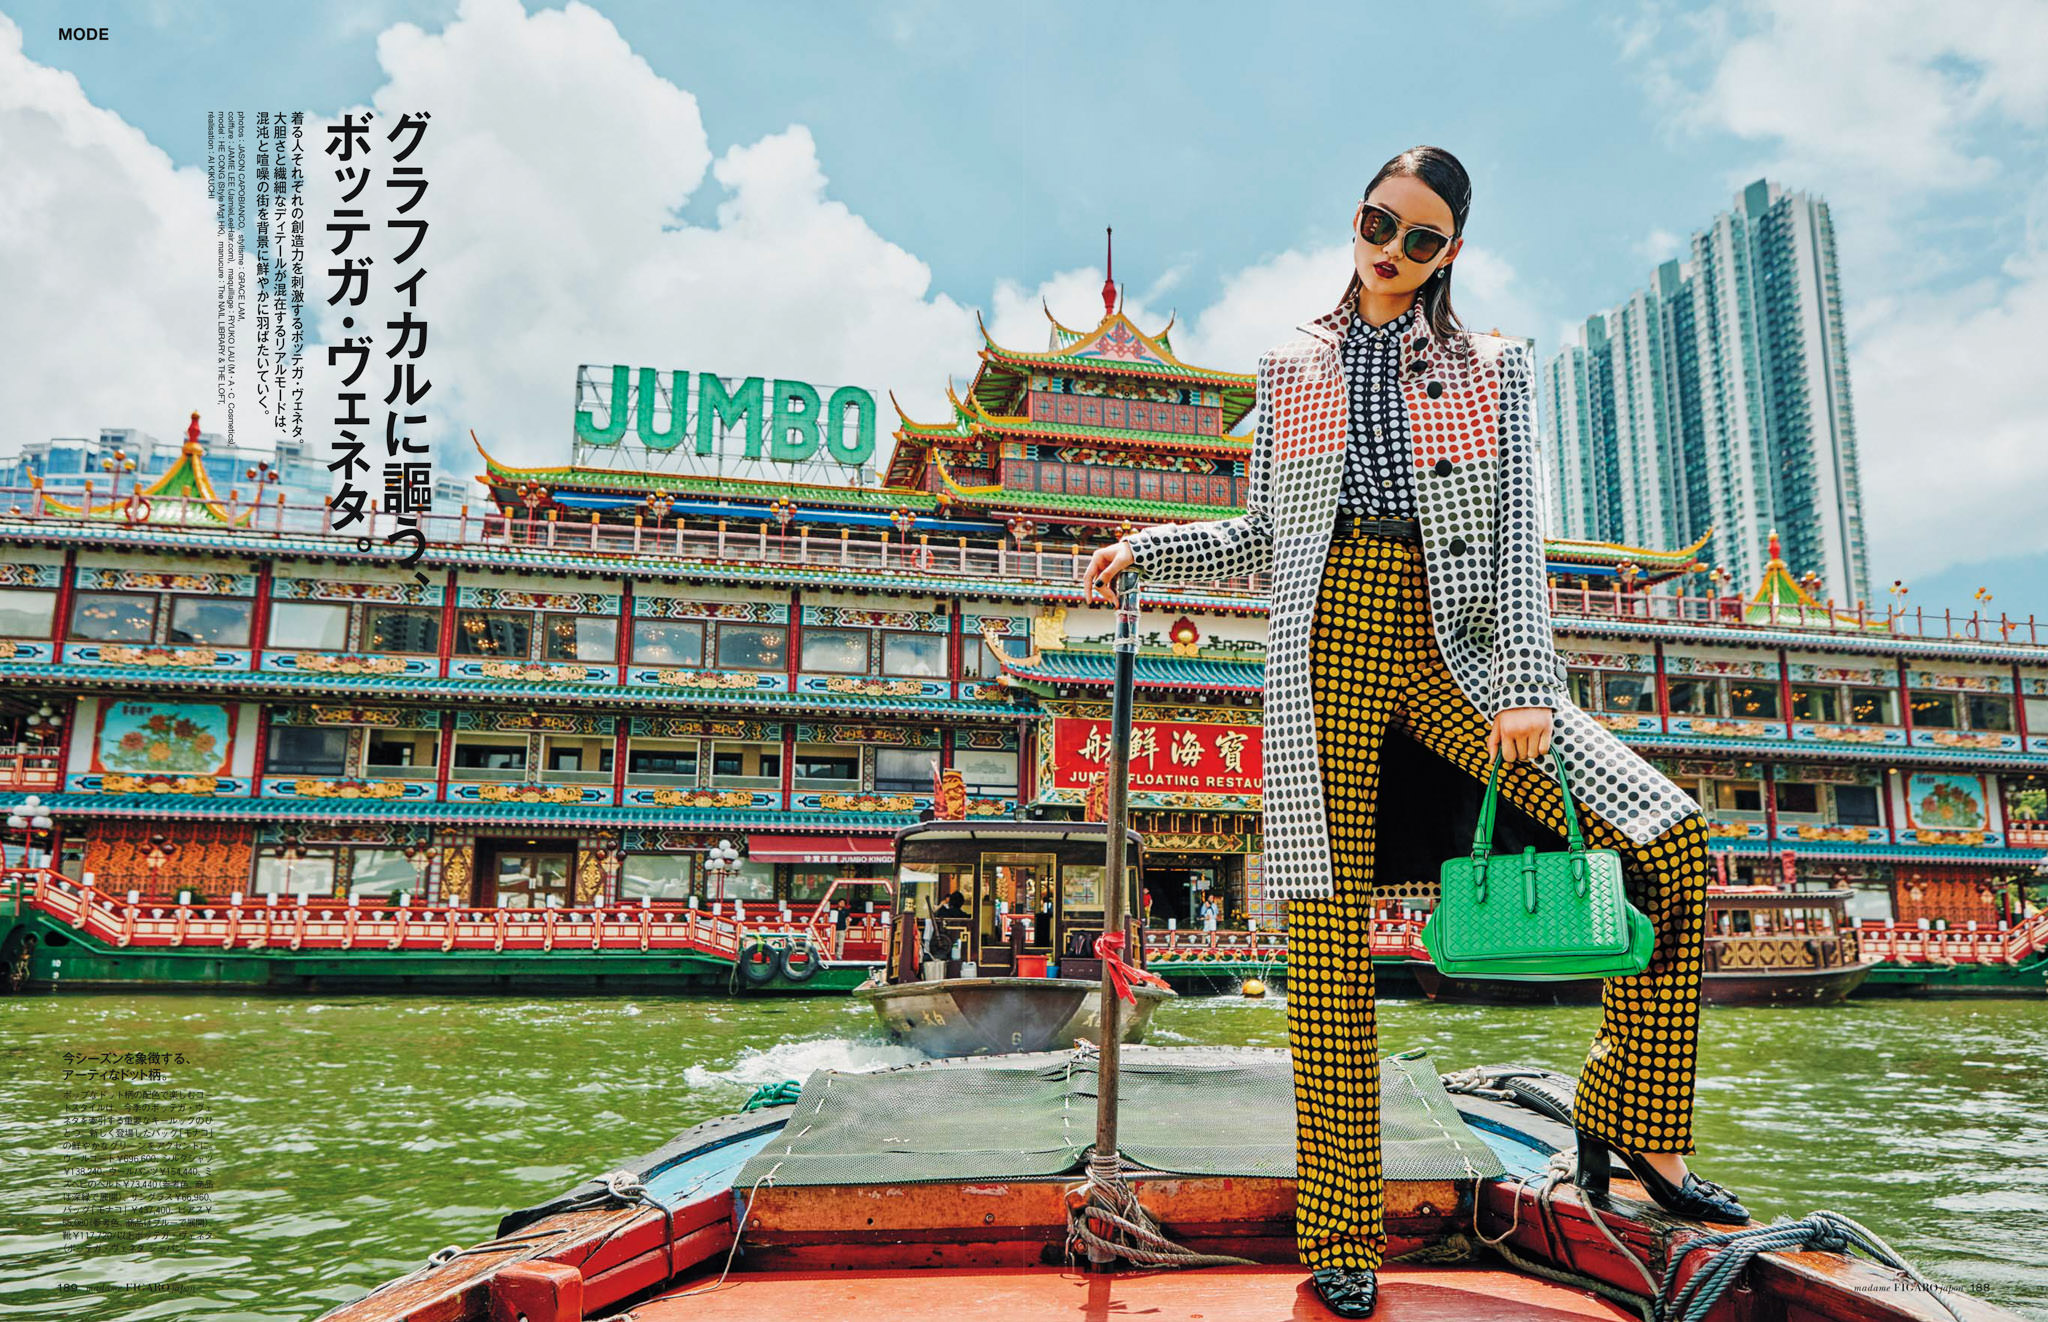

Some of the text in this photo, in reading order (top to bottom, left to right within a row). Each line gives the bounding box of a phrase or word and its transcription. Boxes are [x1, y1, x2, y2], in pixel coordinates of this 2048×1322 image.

[575, 364, 876, 465] JUMBO
[1128, 773, 1200, 787] FLOATING
[1205, 776, 1263, 789] RESTAU
[840, 855, 867, 864] JUMBO
